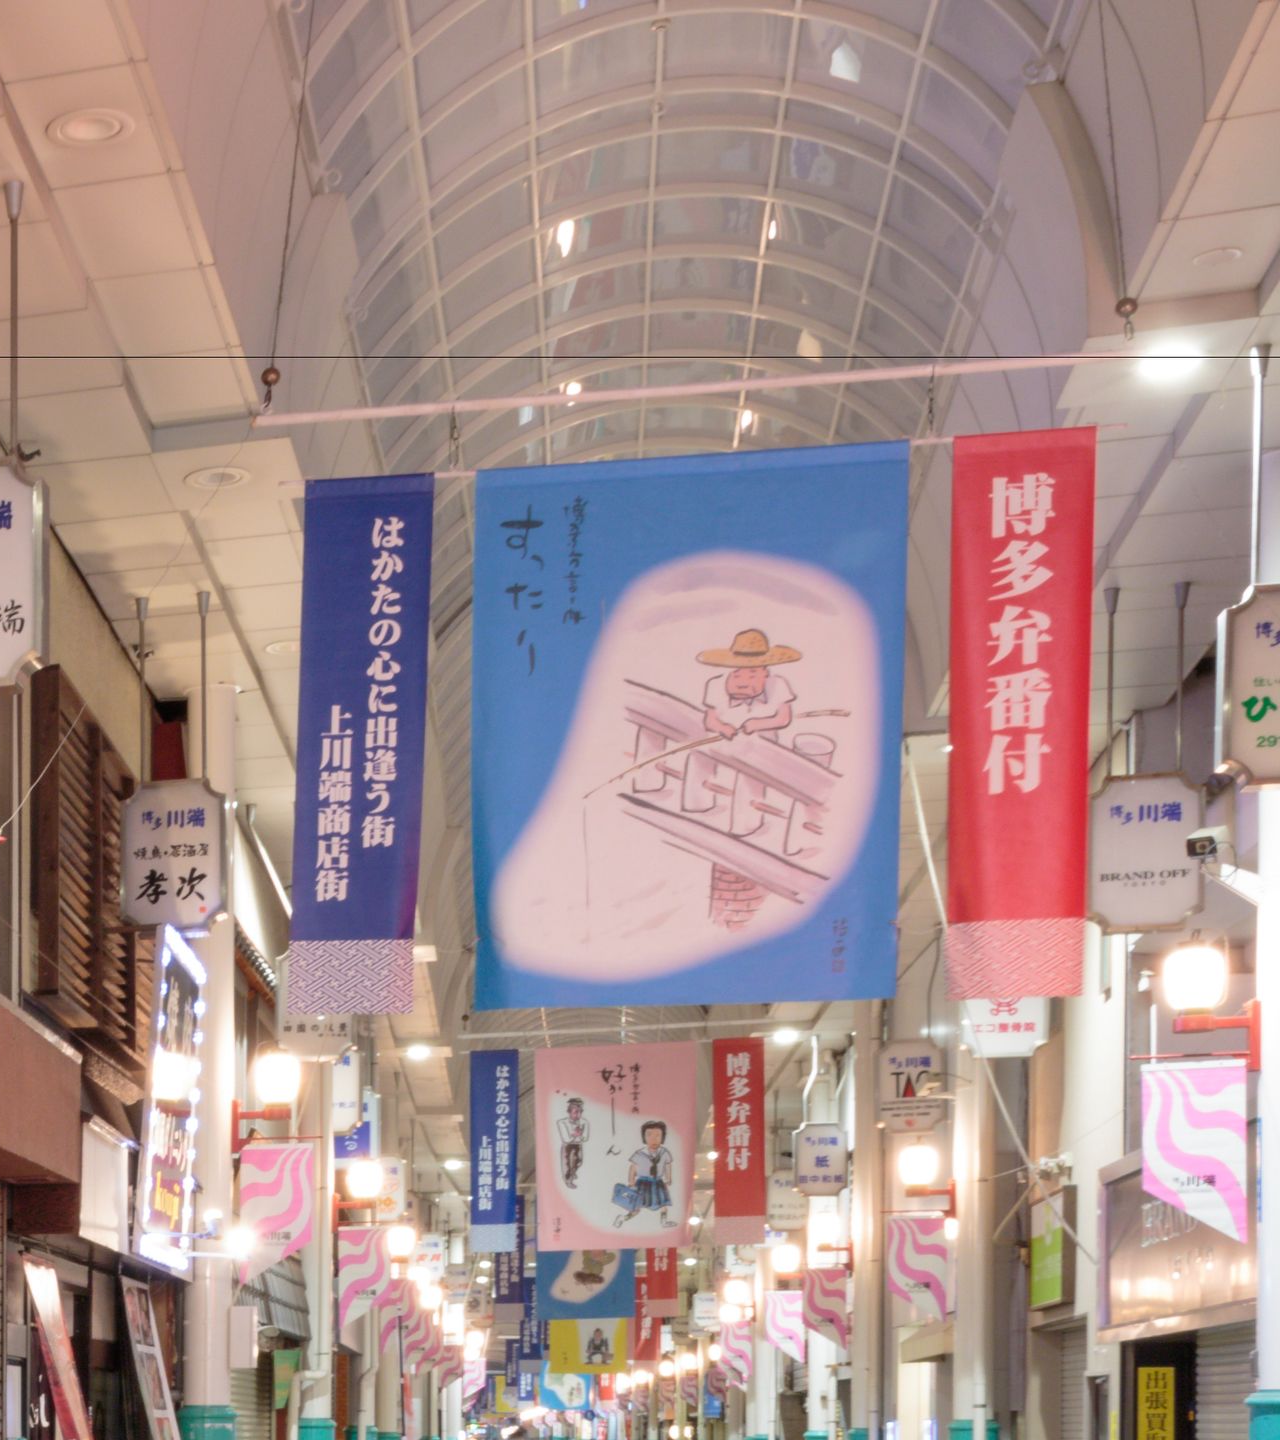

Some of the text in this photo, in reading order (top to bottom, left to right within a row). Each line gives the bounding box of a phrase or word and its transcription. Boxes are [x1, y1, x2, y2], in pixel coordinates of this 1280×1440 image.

[361, 517, 406, 848] はかたの心に出逢う街
[982, 471, 1057, 796] 博多弁番付
[315, 705, 355, 903] 上川端商店街
[135, 867, 208, 905] 孝次
[1100, 868, 1191, 882] BRAND OFF
[495, 1065, 510, 1190] はかたの心に出逢う街
[726, 1053, 751, 1171] 博多弁番付
[478, 1135, 492, 1211] 上川端商店街
